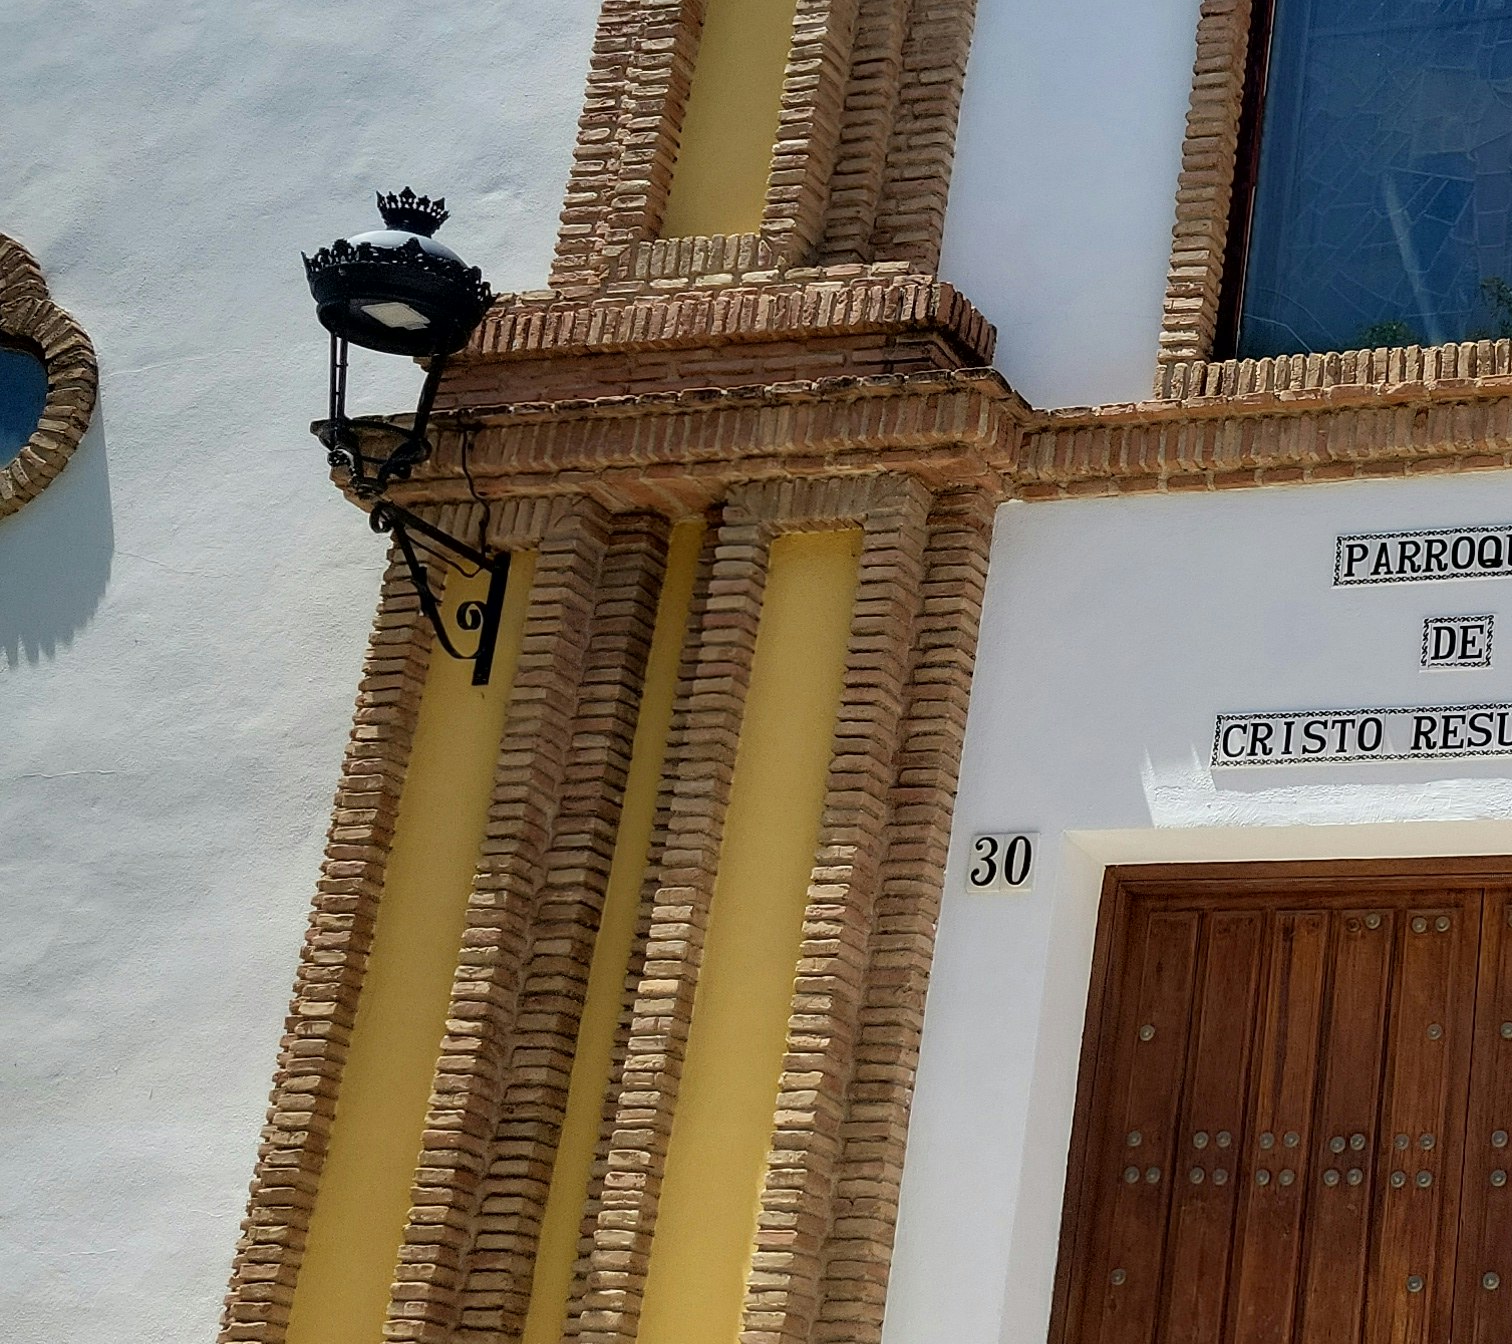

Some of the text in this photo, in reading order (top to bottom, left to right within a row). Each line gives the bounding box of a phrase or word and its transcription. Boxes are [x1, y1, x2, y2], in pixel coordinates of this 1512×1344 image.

[1430, 624, 1485, 661] DE
[1221, 716, 1384, 757] CRISTO
[970, 836, 1032, 887] 30
